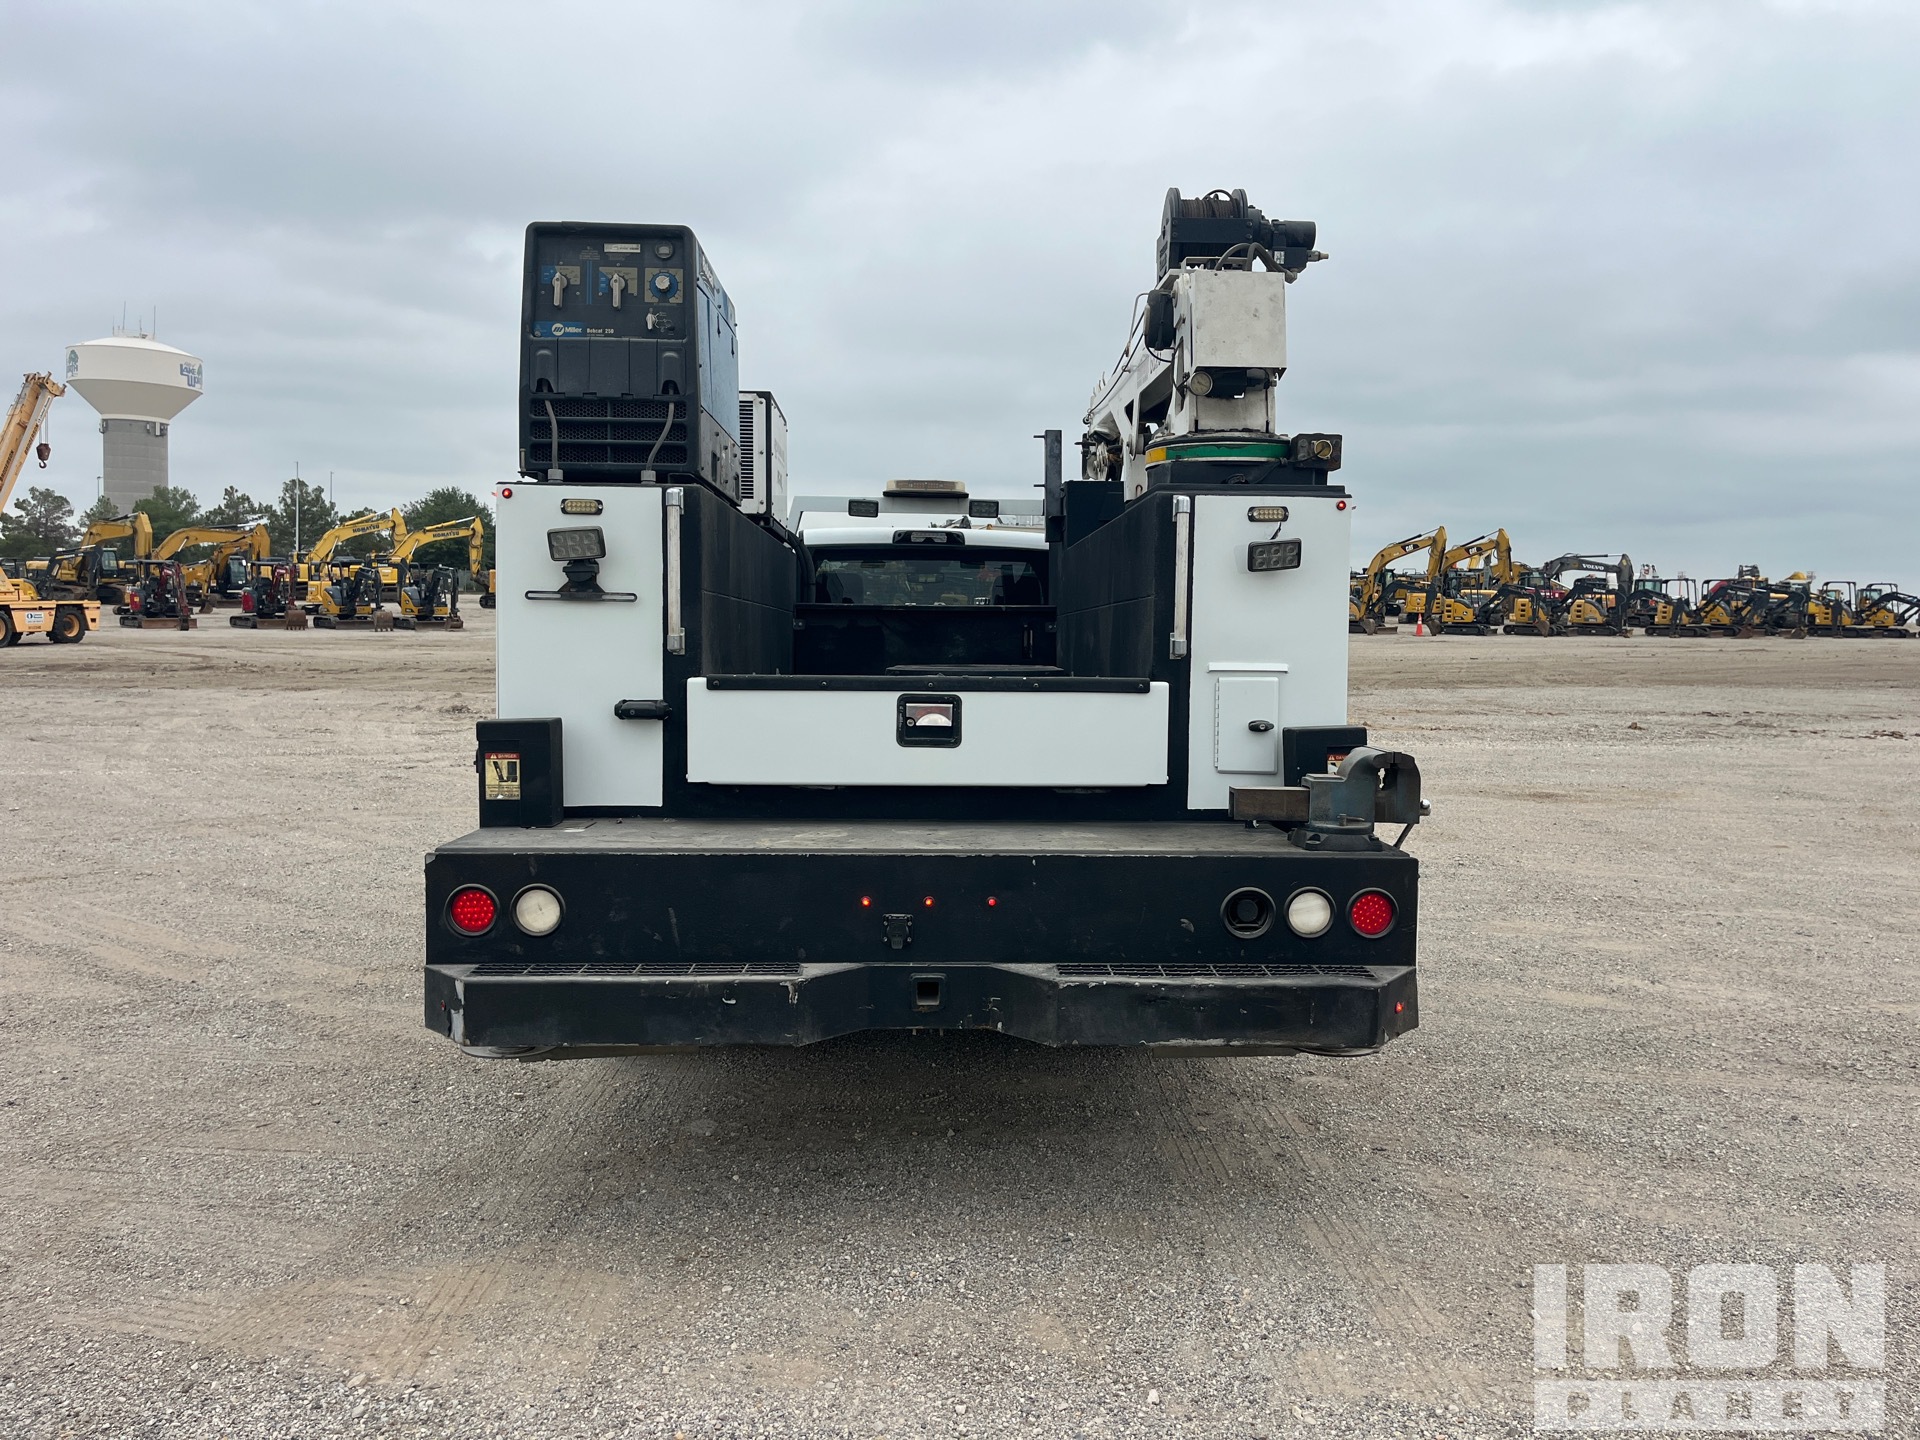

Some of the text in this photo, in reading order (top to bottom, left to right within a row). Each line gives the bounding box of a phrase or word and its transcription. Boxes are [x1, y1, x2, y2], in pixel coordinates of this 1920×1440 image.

[352, 524, 380, 533] KOMATSU
[432, 530, 460, 538] KOMATSU
[1405, 544, 1414, 553] CAT
[1582, 563, 1605, 571] VOLVO
